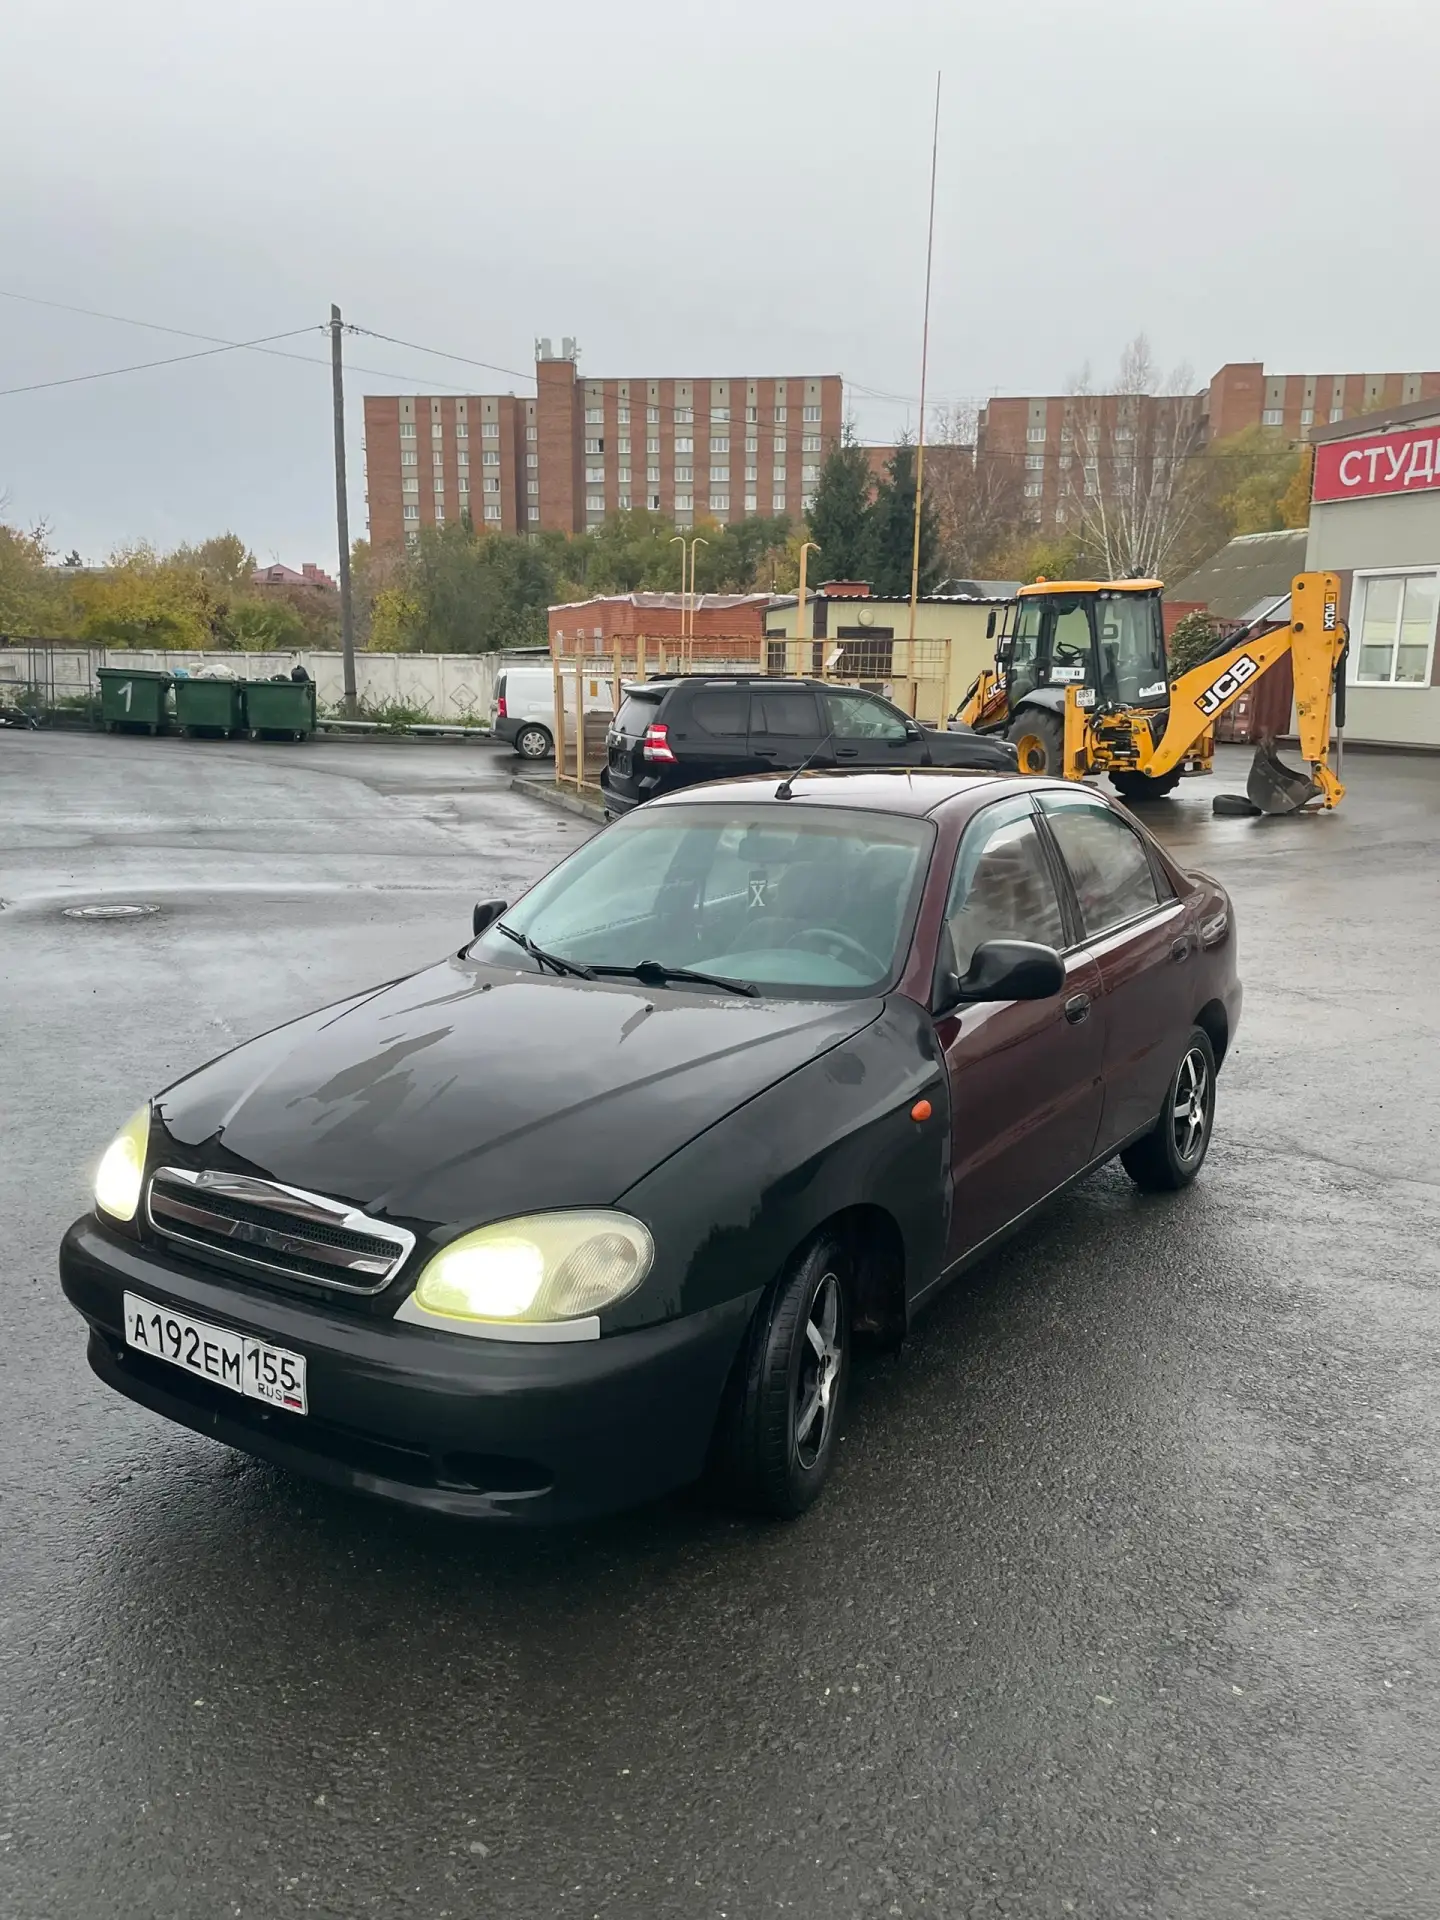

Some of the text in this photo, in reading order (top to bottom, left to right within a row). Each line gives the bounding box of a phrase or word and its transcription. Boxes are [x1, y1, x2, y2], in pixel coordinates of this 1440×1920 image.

[1339, 437, 1440, 487] СТУД
[1324, 603, 1336, 629] 3CX
[117, 681, 133, 713] 1
[1202, 657, 1257, 714] JCB
[247, 1348, 296, 1391] 155
[257, 1382, 283, 1401] RUS
